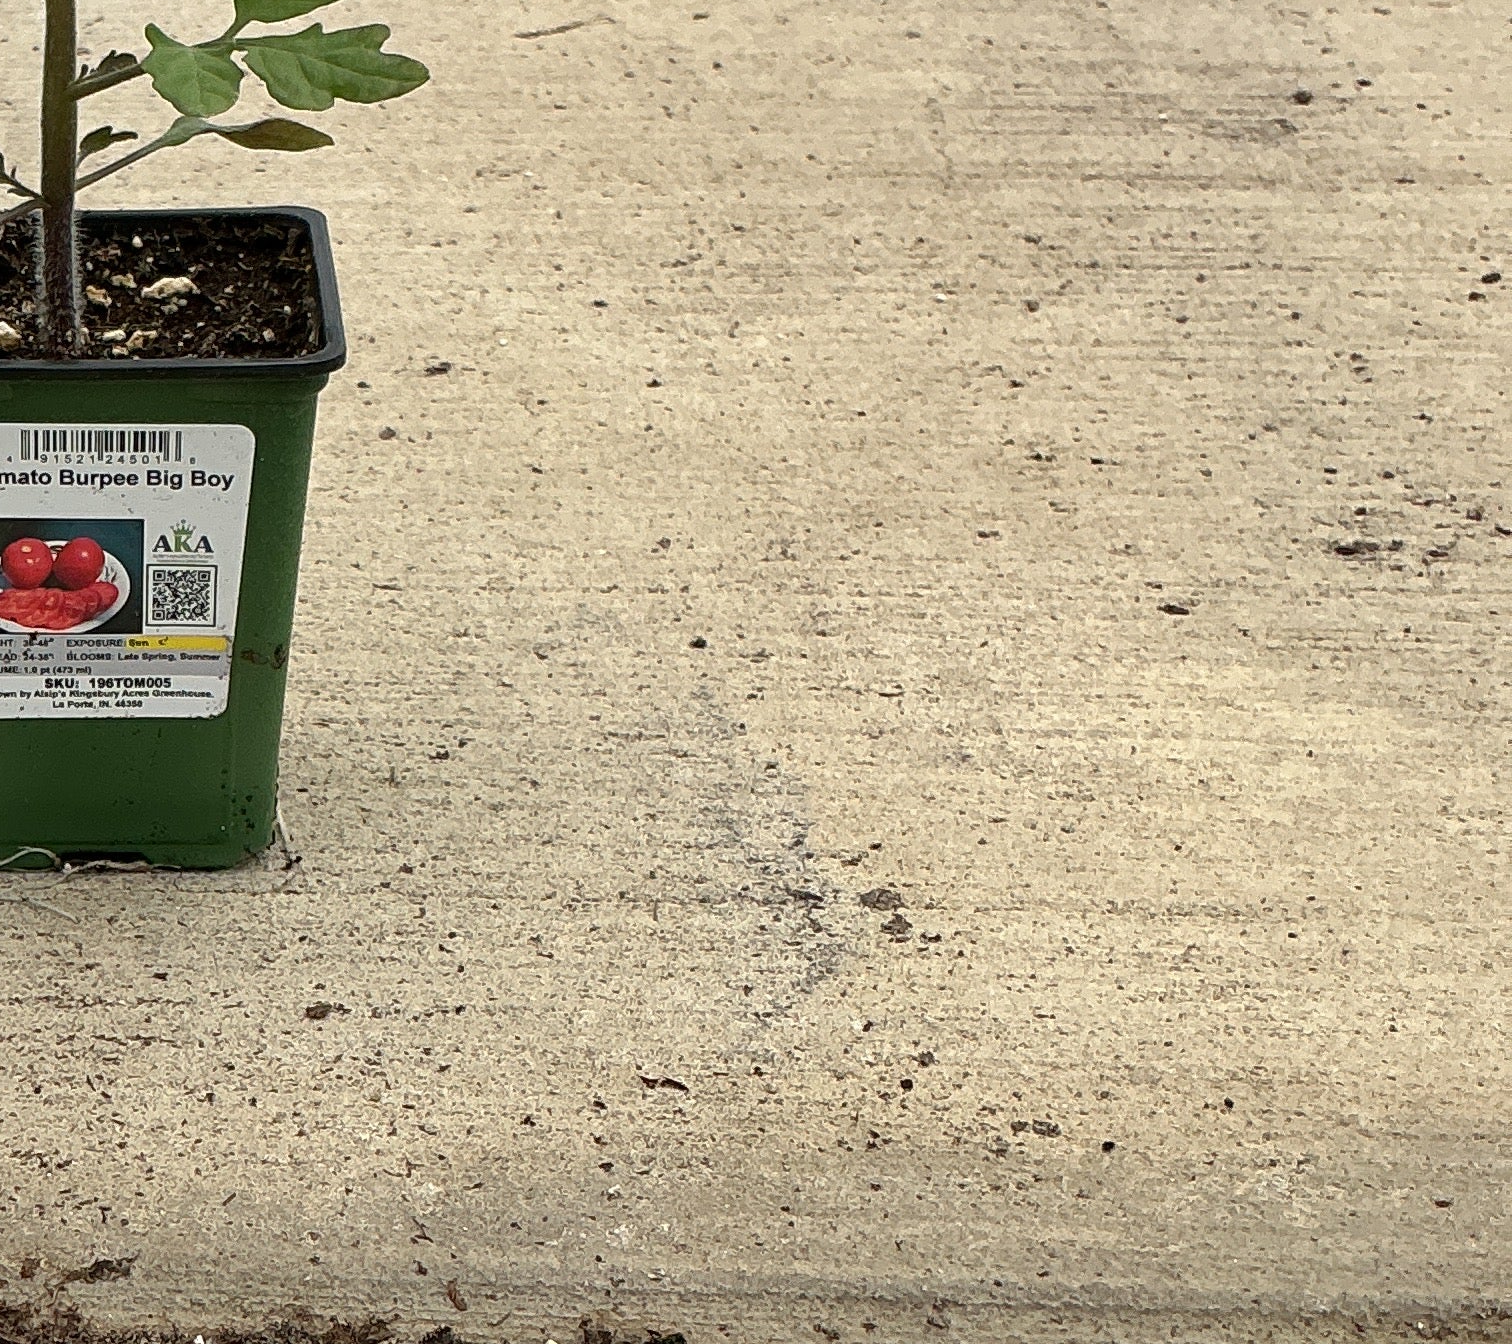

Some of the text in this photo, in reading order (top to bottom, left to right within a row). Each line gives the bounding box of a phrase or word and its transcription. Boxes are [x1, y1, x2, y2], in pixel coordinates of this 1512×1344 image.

[59, 469, 139, 490] Burpee
[146, 470, 183, 491] Big
[191, 470, 235, 491] Boy
[152, 534, 214, 553] AKA
[118, 653, 139, 661] Late
[180, 653, 220, 661] Summer
[40, 666, 50, 675] pt
[52, 665, 74, 675] (473
[45, 678, 172, 689] SKU: 196TOM005
[20, 690, 31, 700] by
[69, 690, 119, 700] Kingsbury
[121, 689, 150, 697] Acres
[53, 700, 65, 708] La
